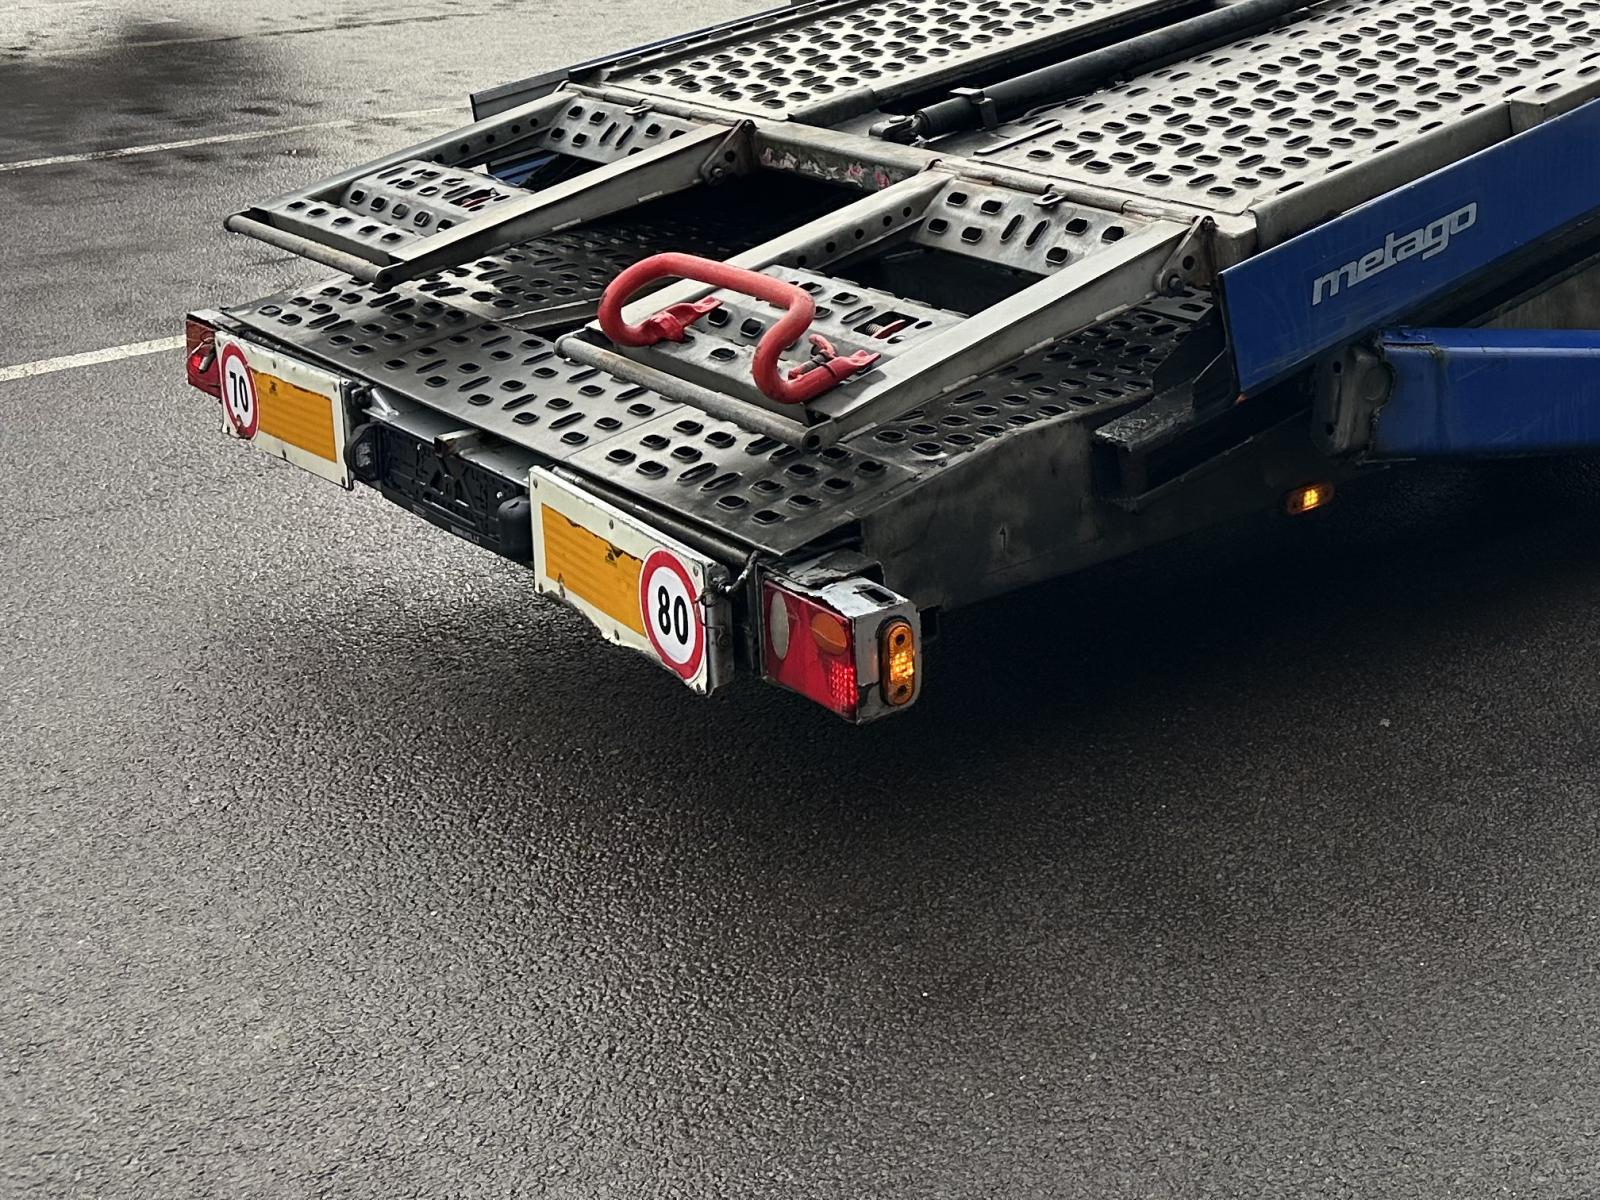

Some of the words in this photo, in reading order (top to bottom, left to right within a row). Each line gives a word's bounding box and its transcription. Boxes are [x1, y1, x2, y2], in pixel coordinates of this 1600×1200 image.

[1312, 202, 1477, 306] metago
[229, 371, 249, 413] 70
[658, 585, 688, 646] 80
